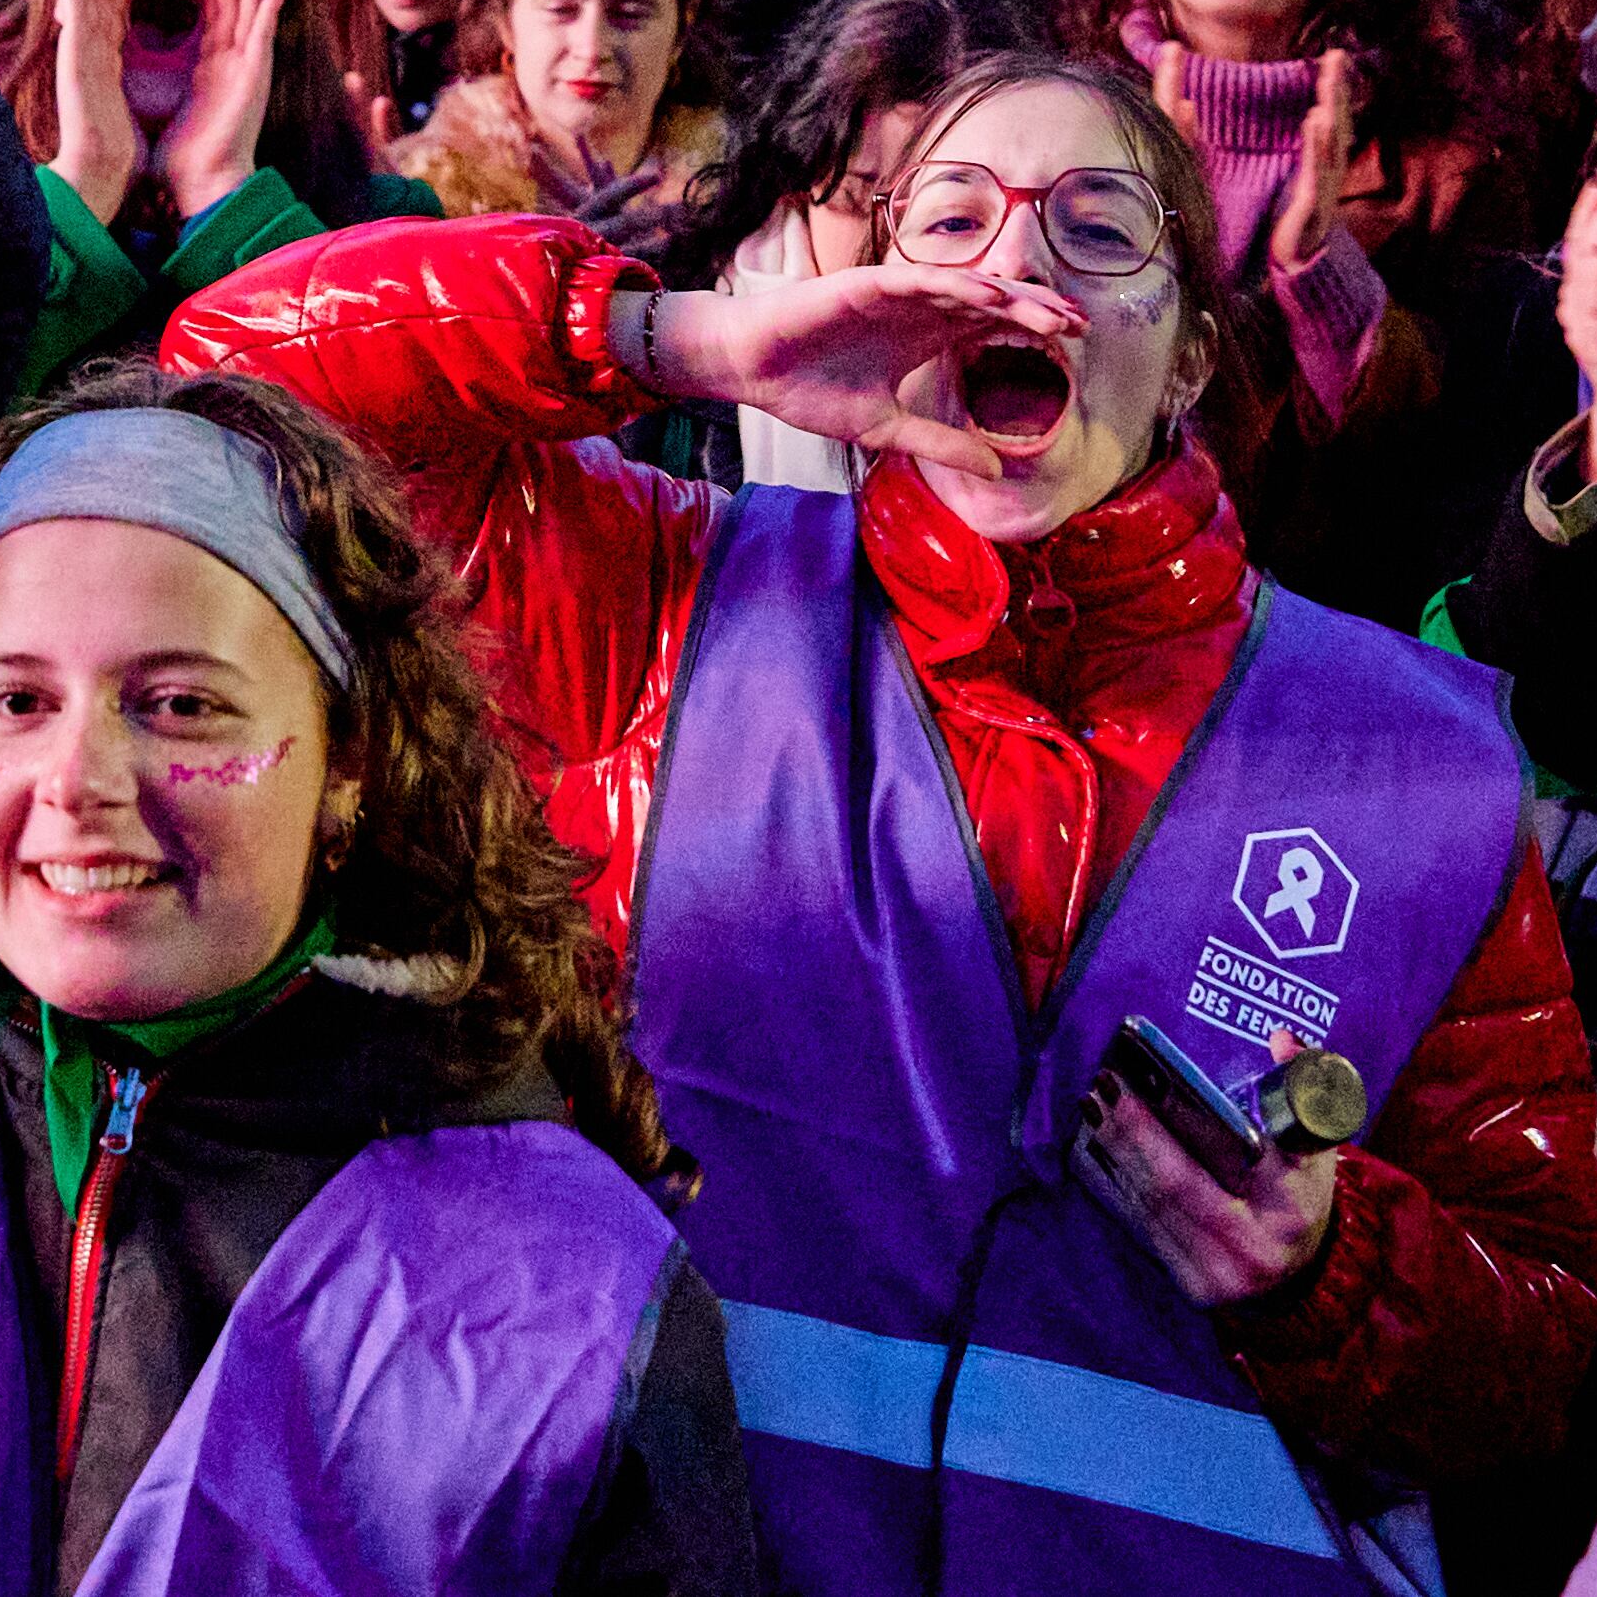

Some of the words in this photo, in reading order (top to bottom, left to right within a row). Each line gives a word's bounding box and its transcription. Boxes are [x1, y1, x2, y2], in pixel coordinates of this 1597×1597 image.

[1187, 981, 1231, 1017] DES
[1236, 1004, 1323, 1049] FEM
[1198, 946, 1337, 1028] FONDATION
